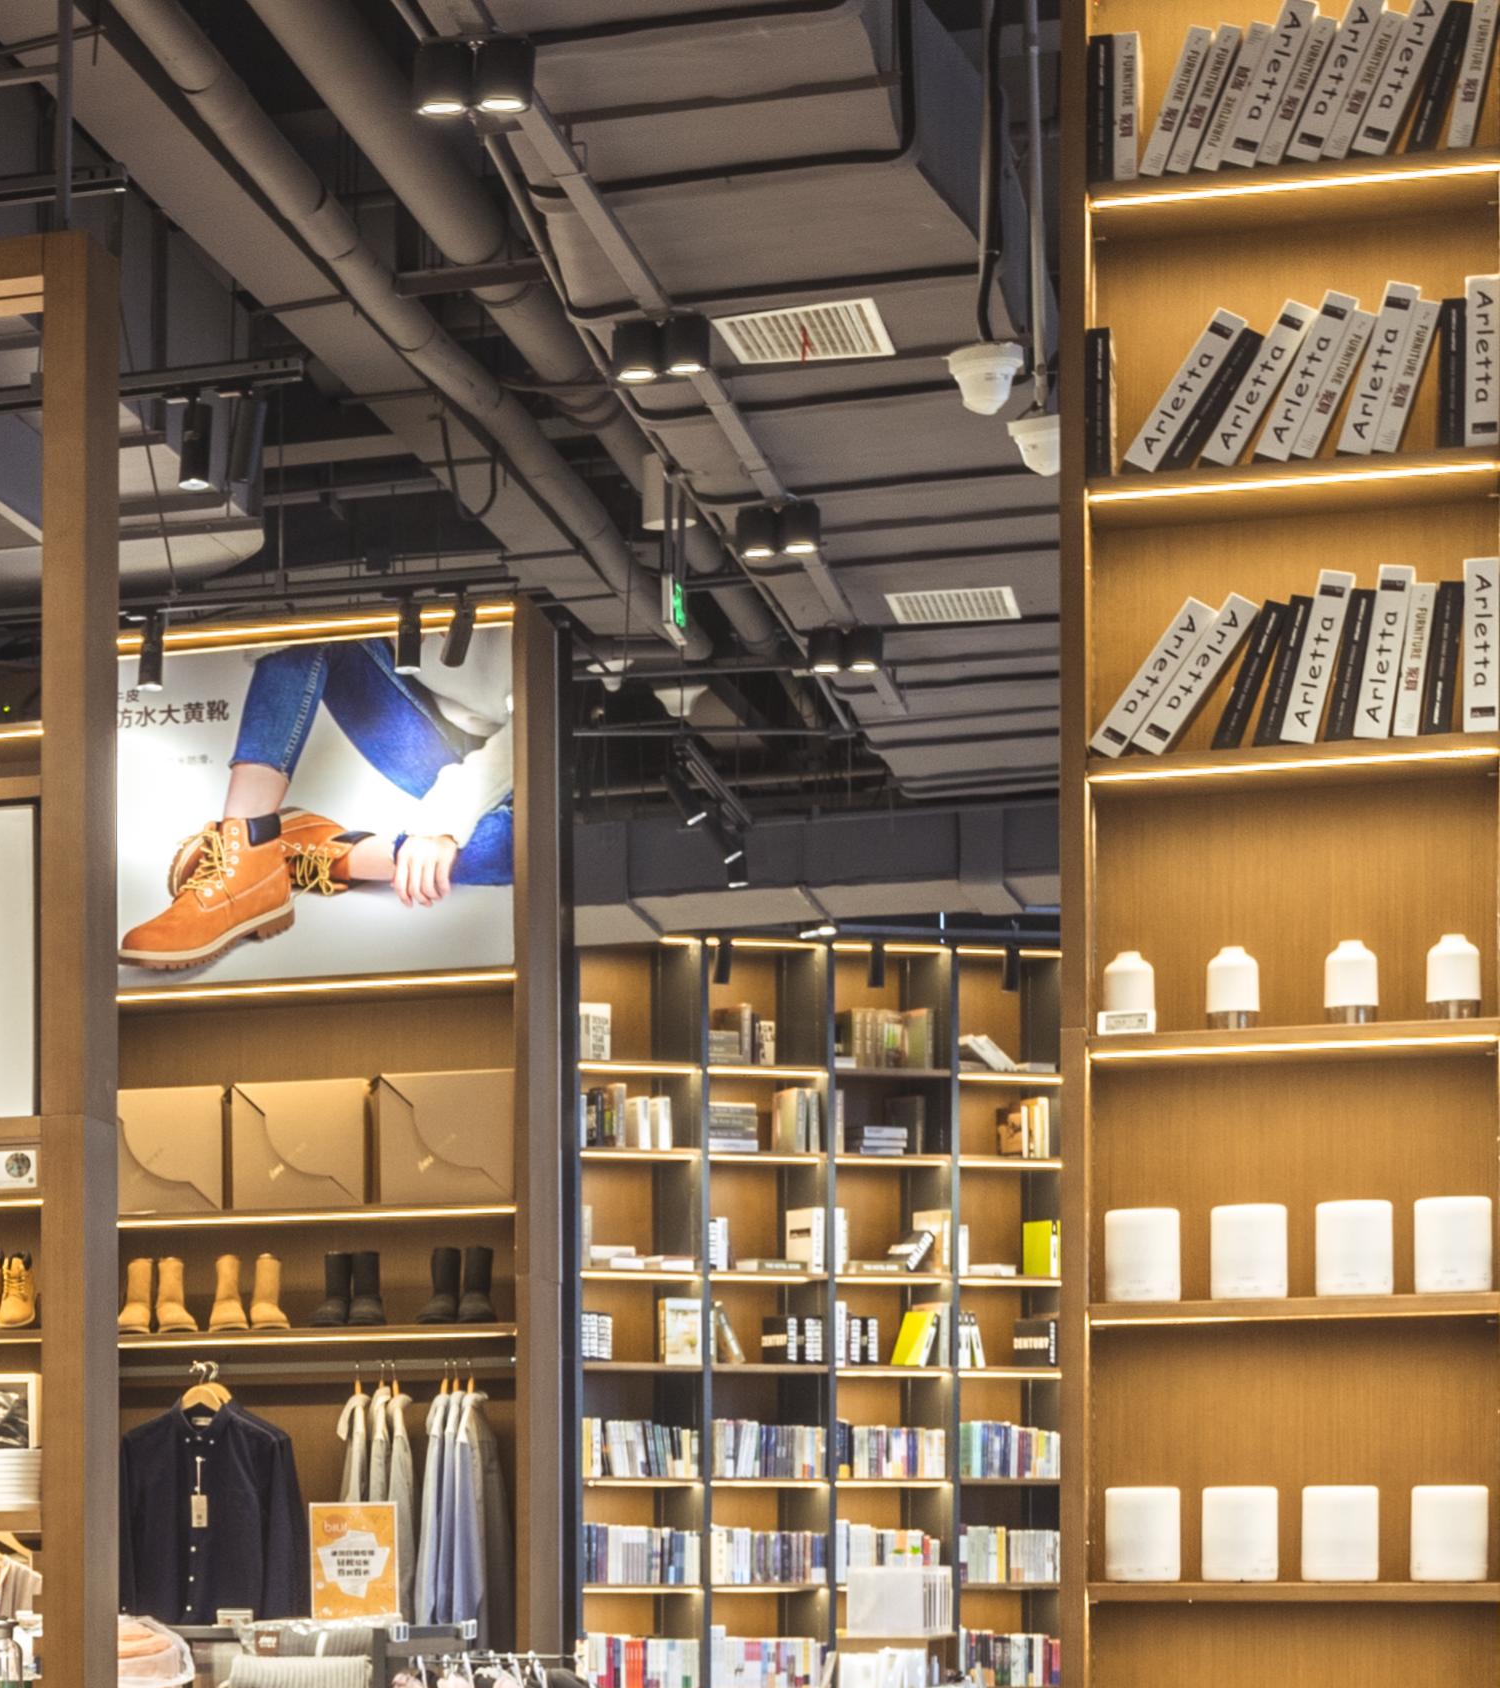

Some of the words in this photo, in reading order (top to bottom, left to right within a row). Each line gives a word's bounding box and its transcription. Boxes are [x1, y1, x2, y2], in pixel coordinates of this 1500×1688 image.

[1122, 54, 1134, 106] FURNITURE
[1173, 50, 1201, 103] FURNITURE
[1201, 48, 1229, 99] FURNITURE
[1248, 11, 1302, 120] Arletta
[1294, 39, 1324, 91] FURNITURE
[1313, 7, 1370, 115] Arletta
[1361, 33, 1391, 85] FURNITURE
[1379, 0, 1435, 109] Arletta
[1470, 18, 1491, 71] FURNITURE
[1208, 96, 1236, 148] FURNITURE
[1273, 336, 1331, 443] Arletta
[1331, 334, 1363, 385] FURNITURE
[1352, 328, 1399, 439] Arletta
[1403, 324, 1429, 377] FURNITURE
[1474, 290, 1495, 403] Arletta
[1143, 353, 1214, 454] Arletta
[1220, 346, 1286, 450] Arletta
[1123, 614, 1196, 714] Arletta
[1167, 610, 1238, 710] Arletta
[1295, 616, 1334, 727] Arletta
[1366, 612, 1398, 723] Arletta
[1411, 607, 1428, 660] FURNITURE
[1474, 574, 1493, 687] Arletta
[1013, 1337, 1049, 1350] CENTURY
